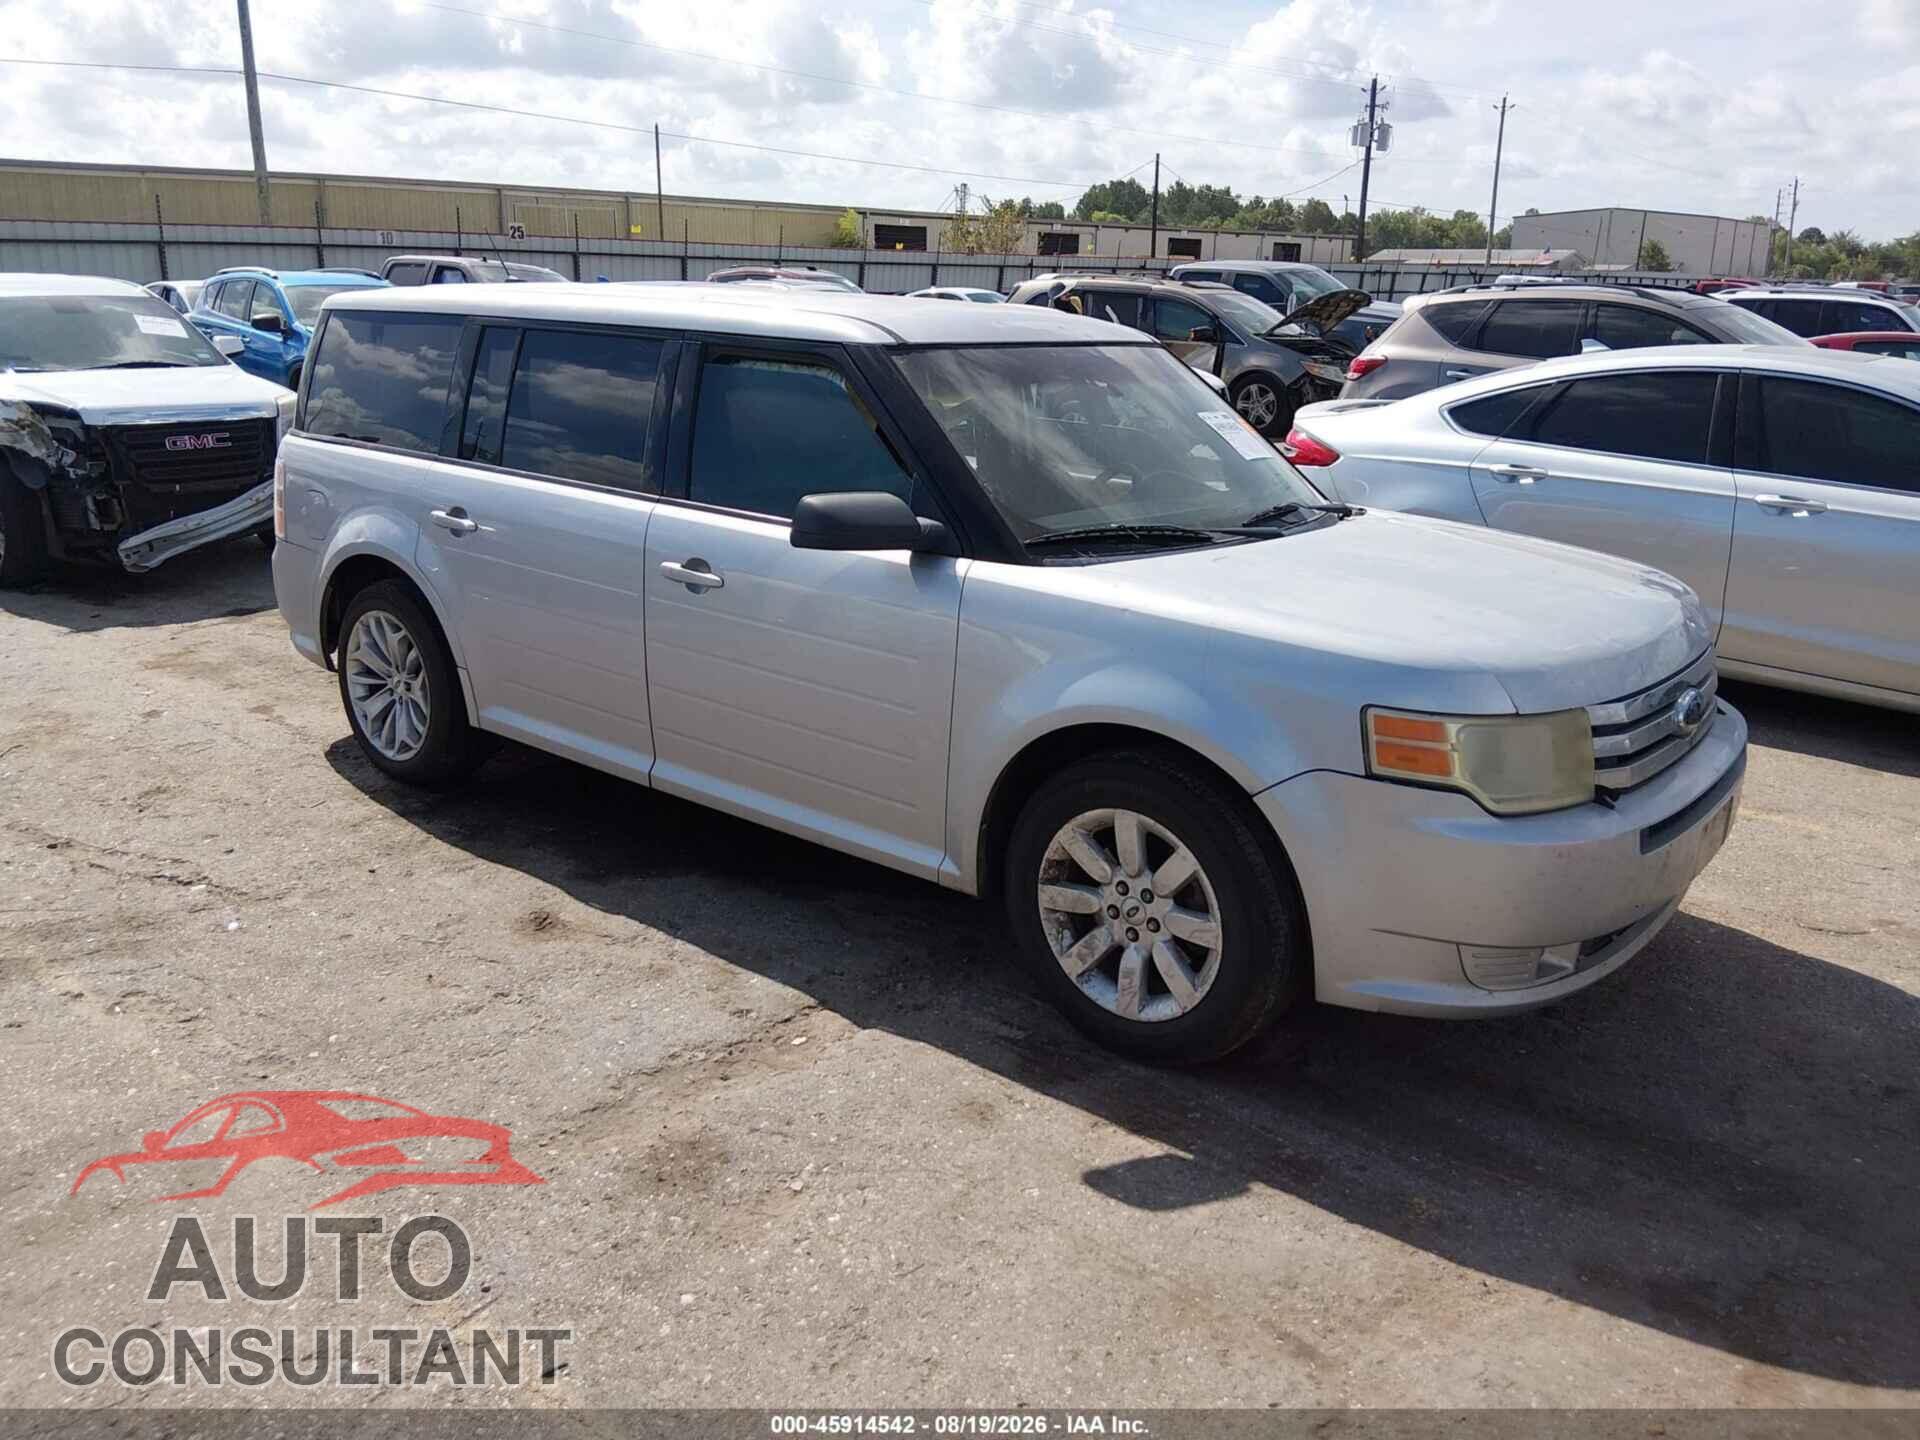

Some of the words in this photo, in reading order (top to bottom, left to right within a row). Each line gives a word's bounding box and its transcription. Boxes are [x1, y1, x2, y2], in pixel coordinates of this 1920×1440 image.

[380, 232, 393, 244] 10
[510, 225, 525, 239] 25
[165, 432, 232, 450] GMC
